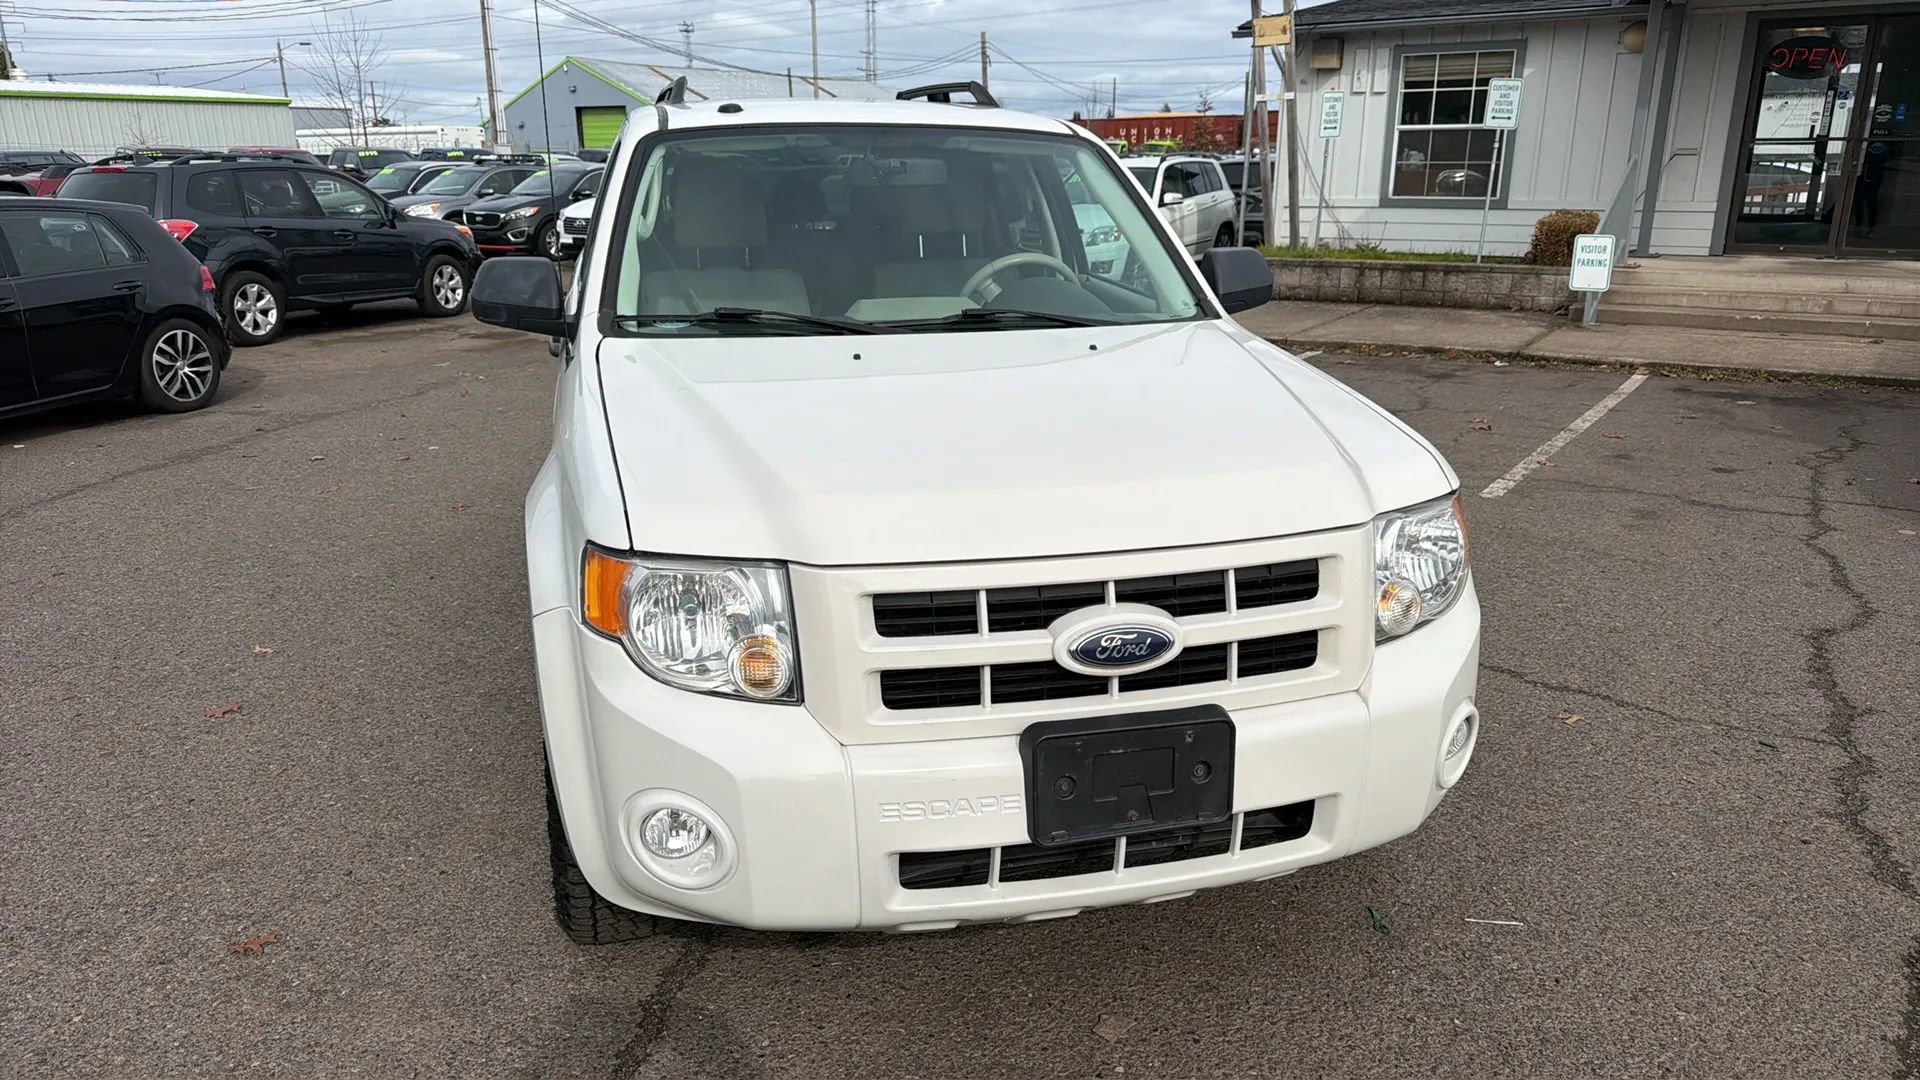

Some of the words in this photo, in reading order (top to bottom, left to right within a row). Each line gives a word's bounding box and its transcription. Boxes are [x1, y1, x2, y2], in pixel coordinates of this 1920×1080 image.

[1772, 48, 1848, 72] OPEN
[1491, 107, 1514, 115] PARKING
[1119, 127, 1173, 136] UNION
[1581, 245, 1608, 254] VISITOR
[1577, 258, 1608, 268] PARKING
[1095, 633, 1152, 659] Ford
[878, 793, 1022, 823] ESCAPE
